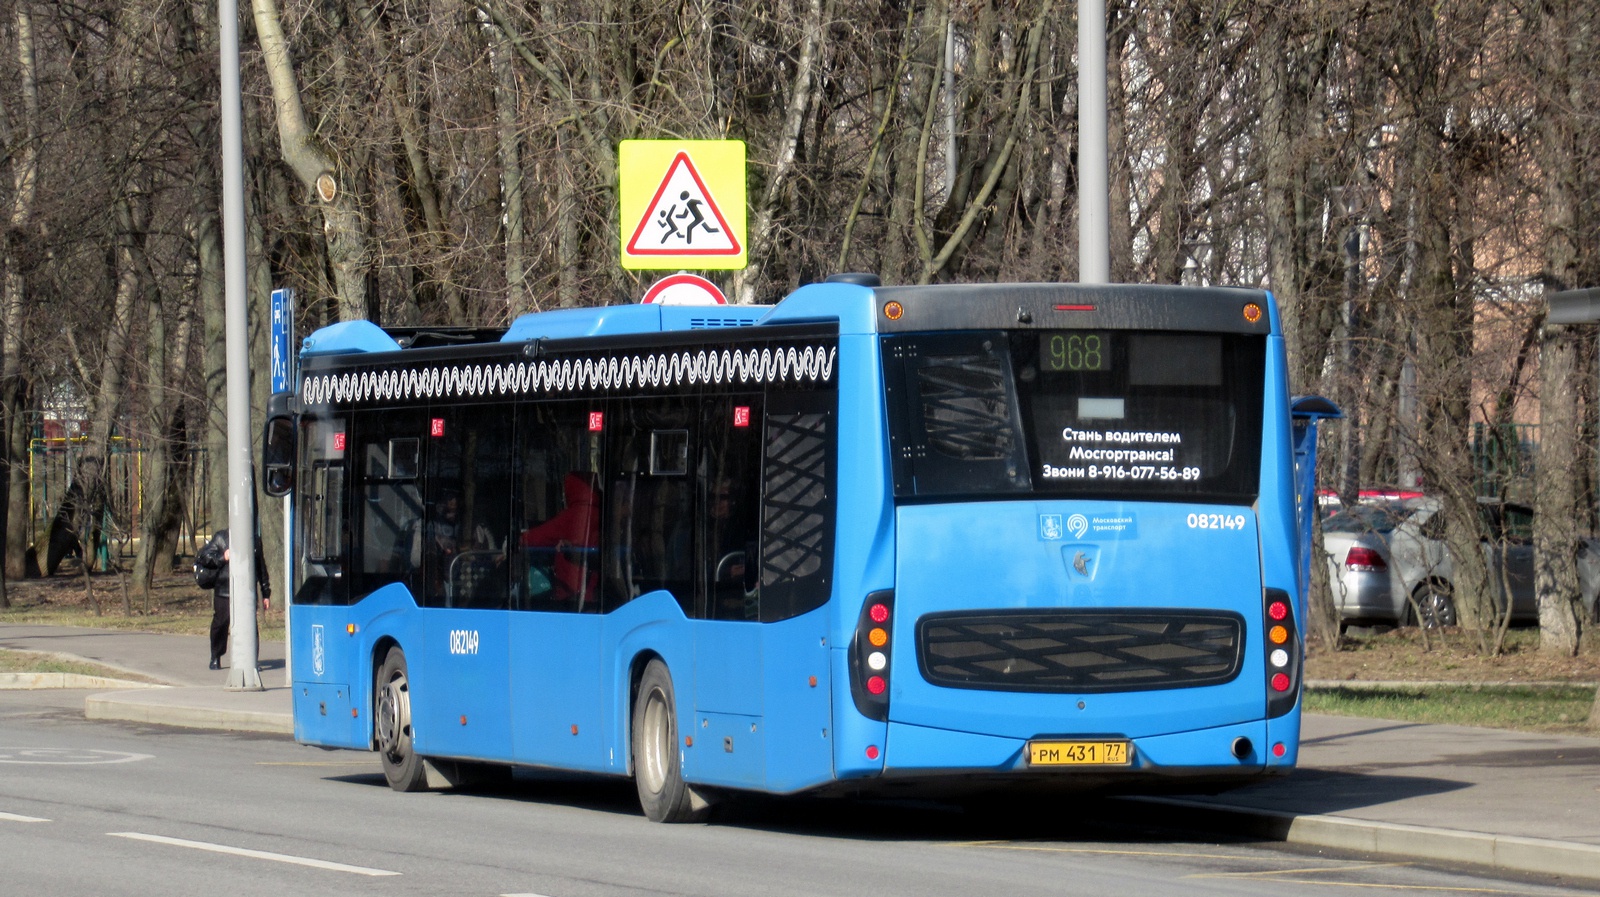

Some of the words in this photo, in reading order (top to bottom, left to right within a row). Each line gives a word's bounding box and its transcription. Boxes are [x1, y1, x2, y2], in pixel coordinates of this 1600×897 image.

[1051, 335, 1101, 370] 968
[1062, 427, 1103, 441] Стань
[1105, 431, 1181, 444] водителем
[1069, 446, 1174, 463] Мосгортранса!
[1042, 464, 1085, 478] Звони
[1088, 465, 1201, 481] 8-916-077-56-89
[1092, 516, 1133, 524] Московский
[1186, 513, 1246, 530] 082149
[450, 629, 479, 655] 082149
[1066, 745, 1096, 761] 431
[1105, 744, 1121, 757] 77
